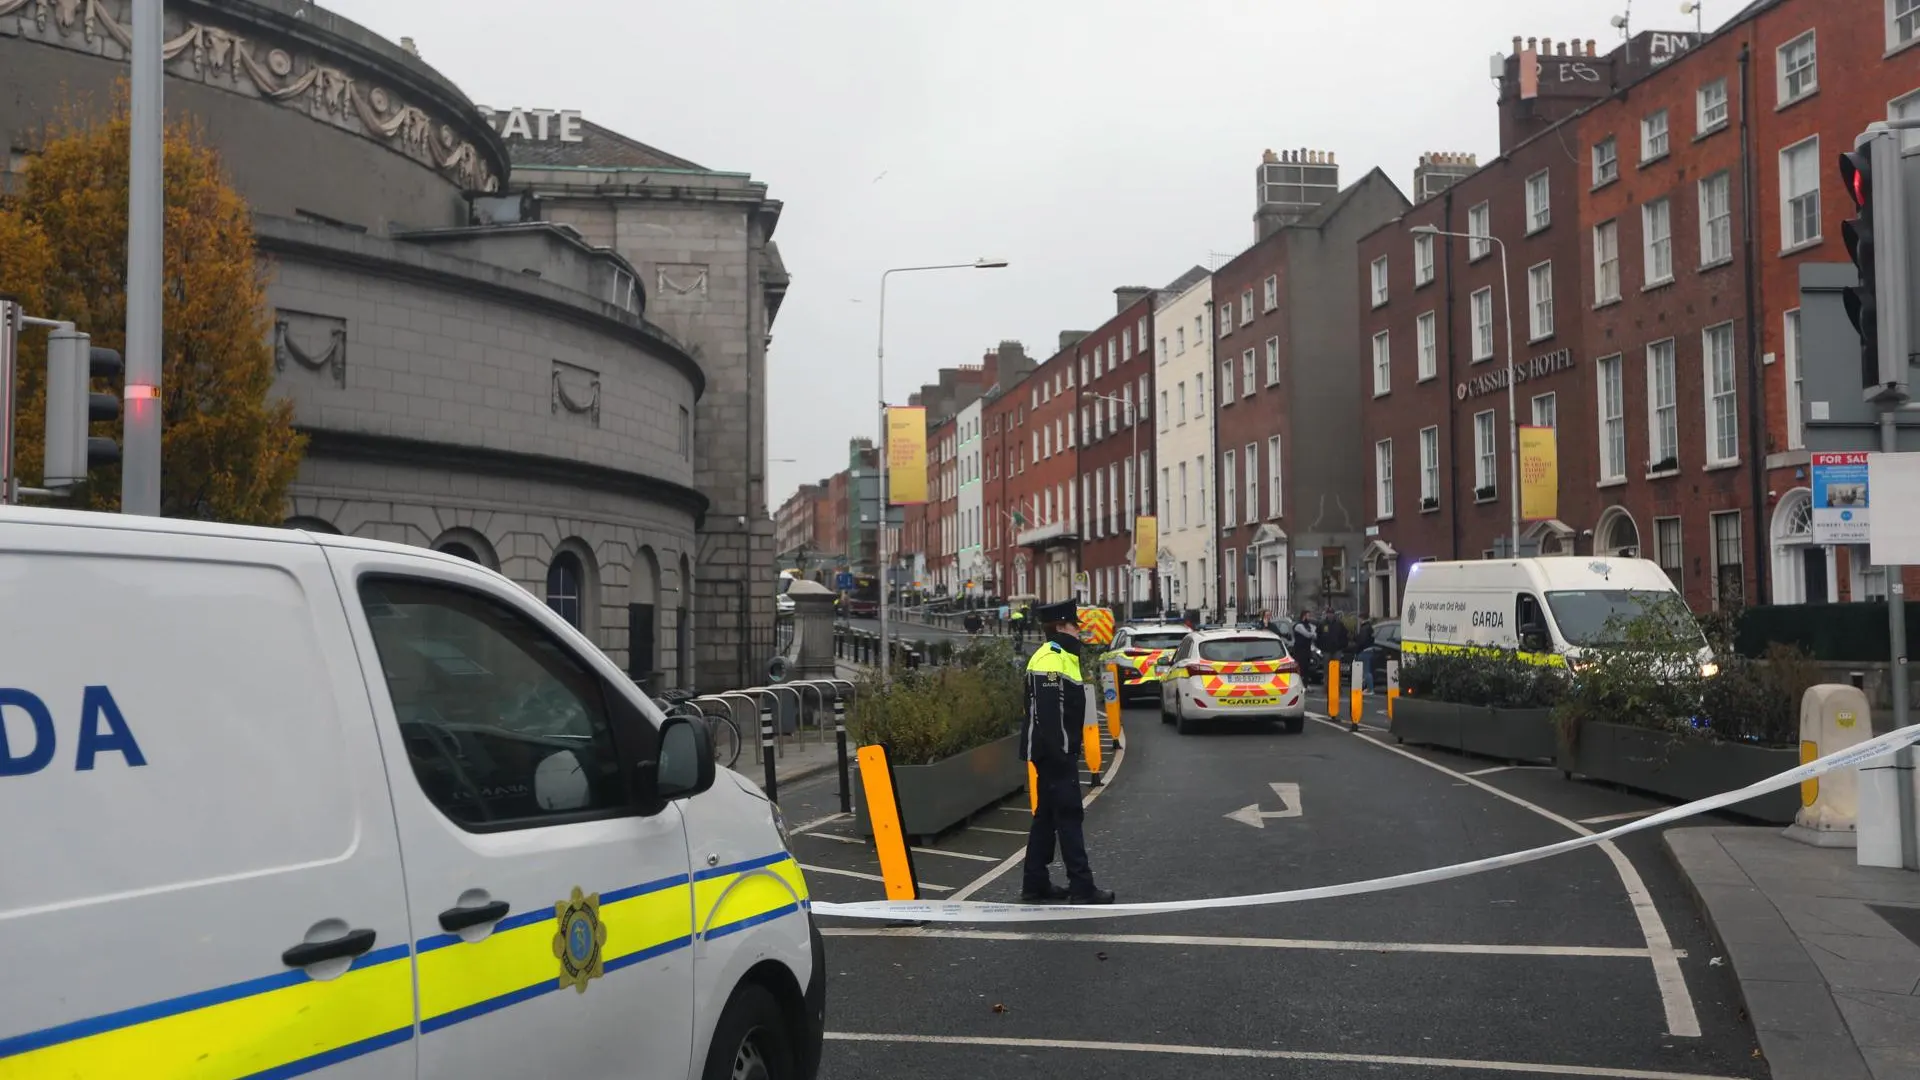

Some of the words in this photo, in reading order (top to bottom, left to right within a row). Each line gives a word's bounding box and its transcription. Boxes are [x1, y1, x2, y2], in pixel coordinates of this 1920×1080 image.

[1650, 33, 1690, 54] AM
[1530, 347, 1575, 378] HOTEL
[1819, 455, 1842, 464] FOR
[1846, 454, 1868, 464] SAL
[1472, 611, 1504, 628] GARDA
[1227, 697, 1270, 705] GARDA
